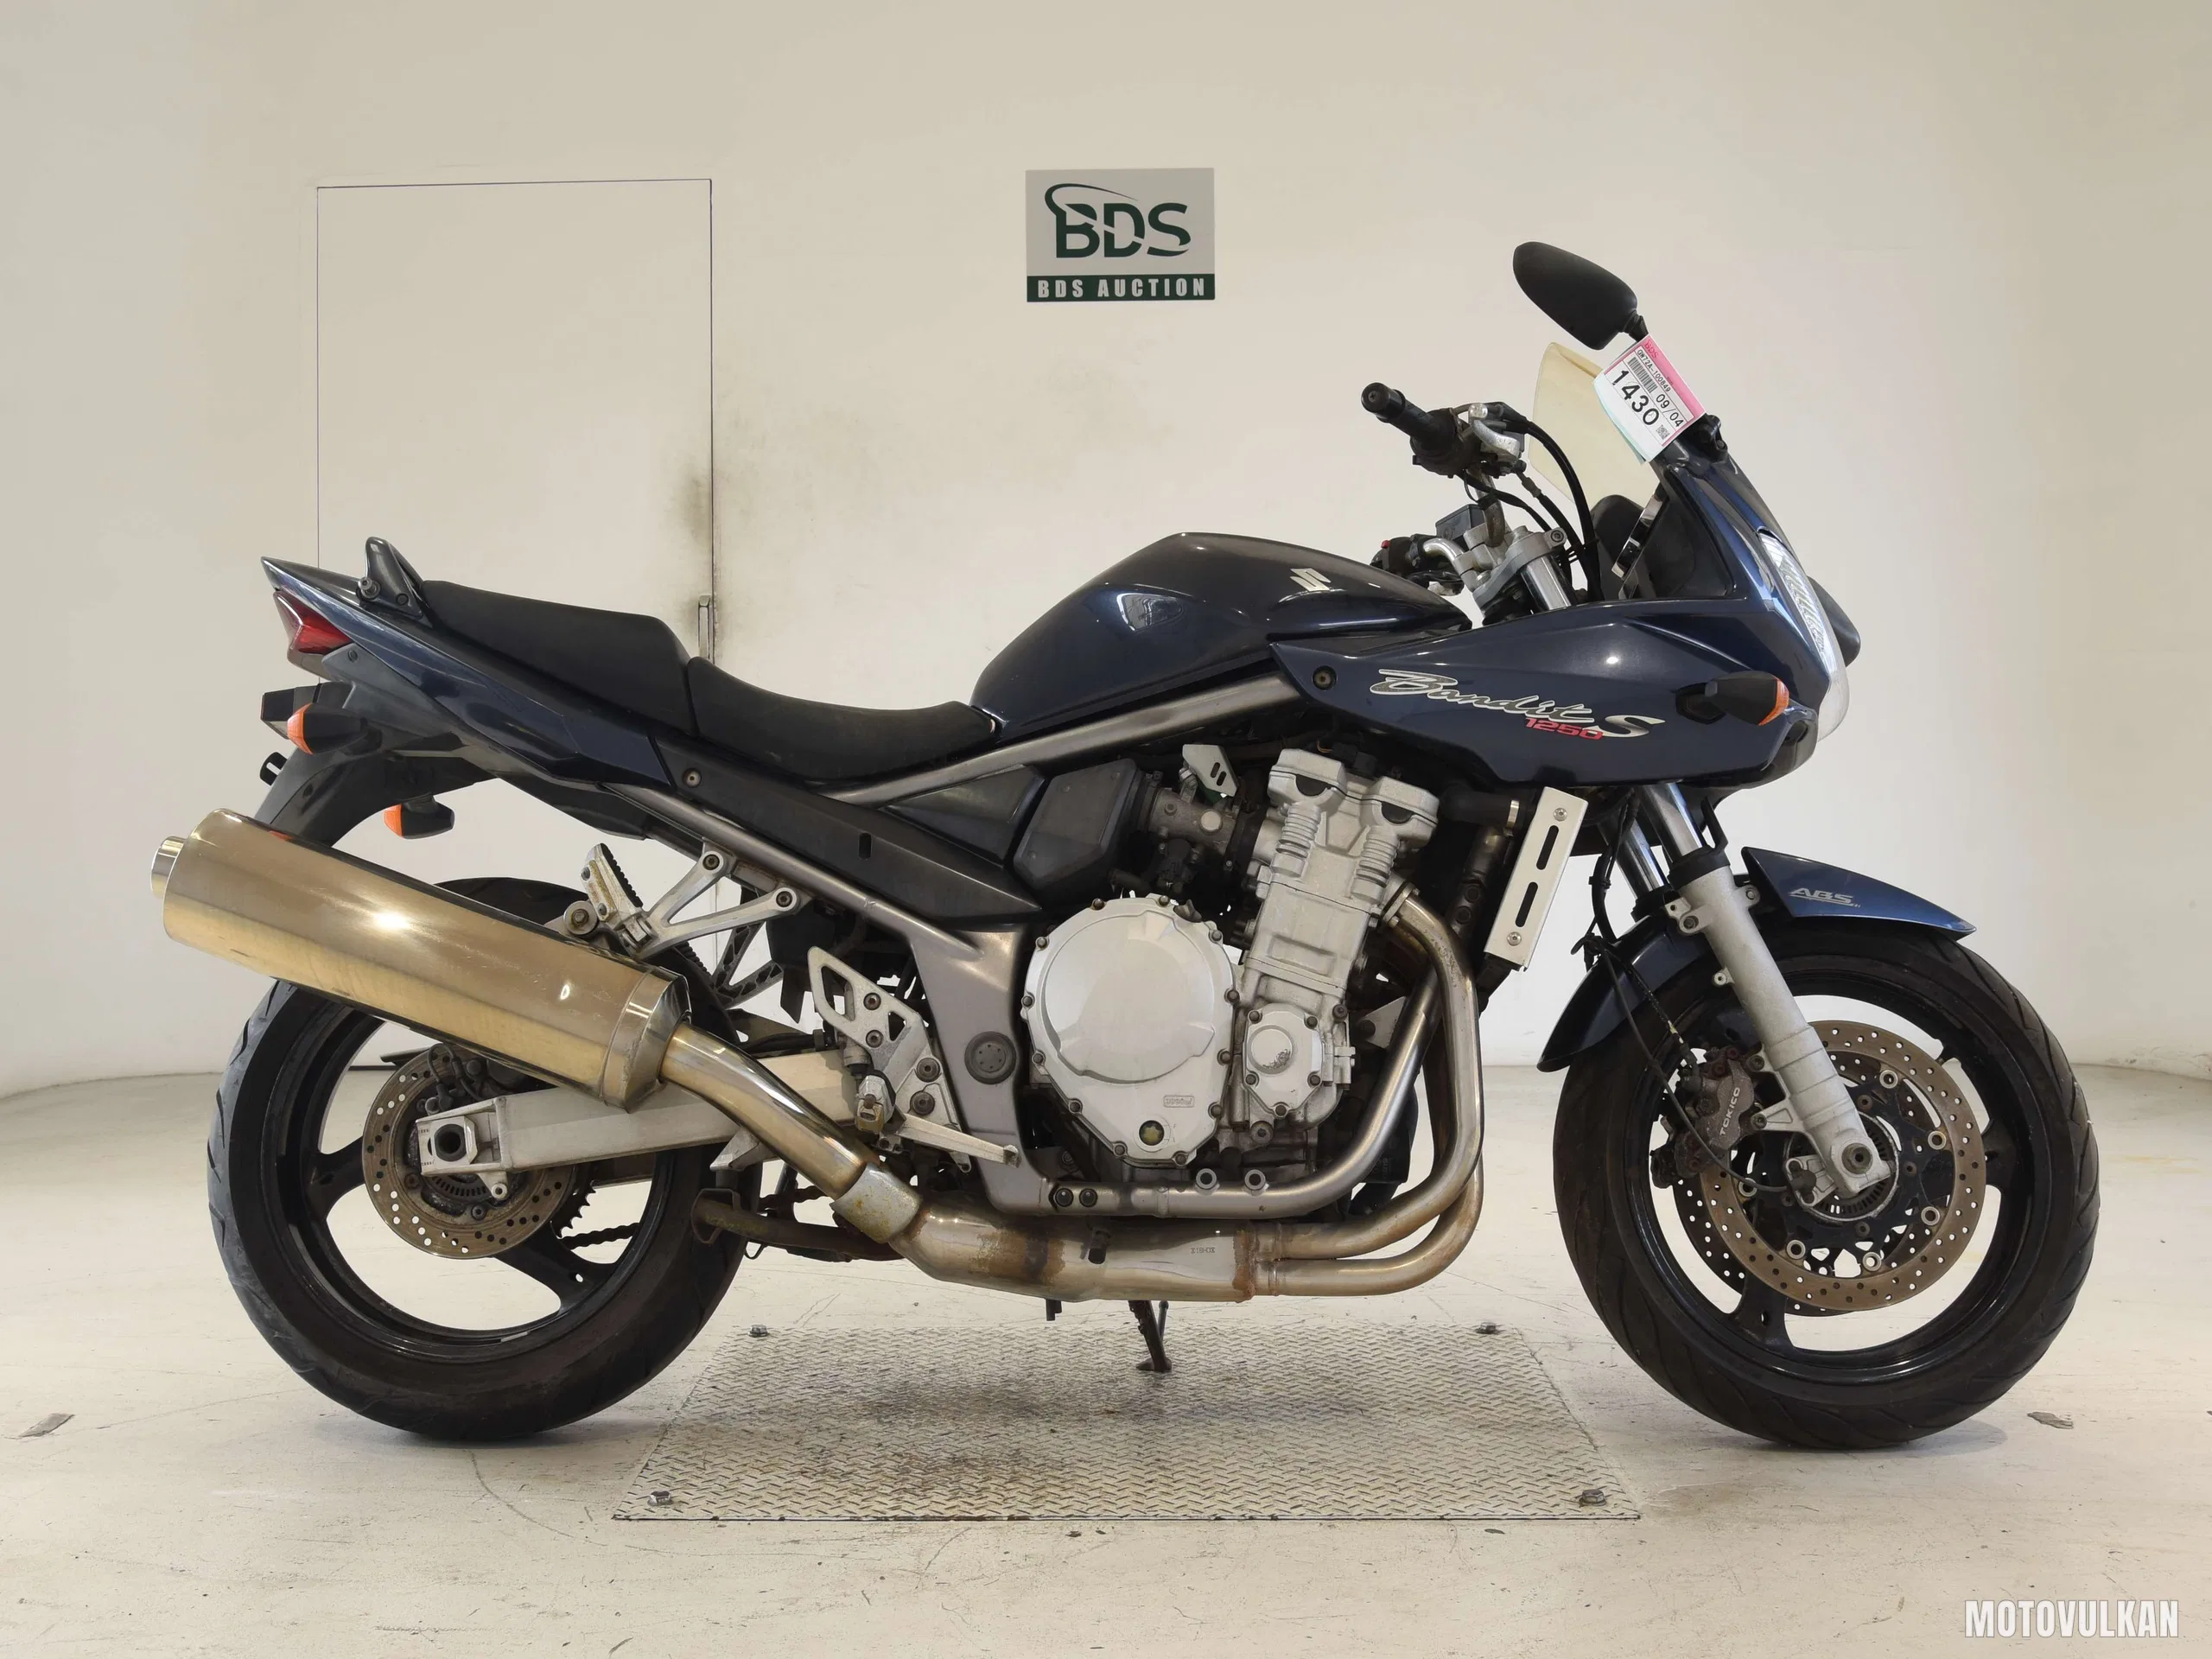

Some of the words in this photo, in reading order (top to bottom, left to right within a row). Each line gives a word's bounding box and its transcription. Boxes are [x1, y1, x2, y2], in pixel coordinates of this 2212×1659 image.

[1045, 183, 1192, 258] BDS
[1038, 278, 1084, 298] BDS
[1097, 277, 1205, 298] AUCTION
[1612, 370, 1660, 426] 1430
[1656, 393, 1684, 428] 09/04
[1370, 668, 1596, 723] Bandit
[1583, 715, 1666, 738] S
[1524, 718, 1604, 741] 1250
[1789, 887, 1854, 905] ABS
[1719, 1087, 1741, 1136] TOKICO
